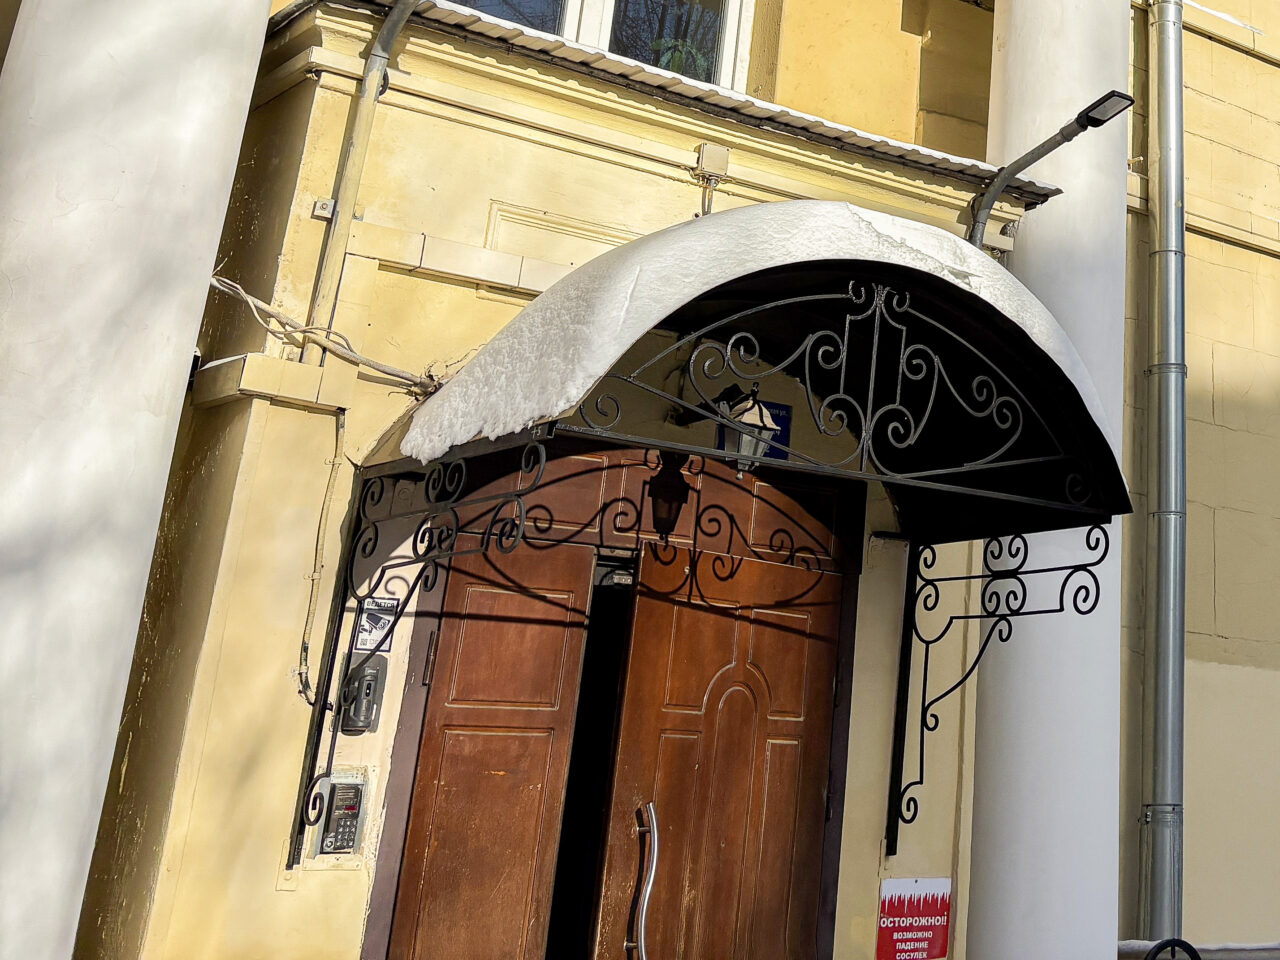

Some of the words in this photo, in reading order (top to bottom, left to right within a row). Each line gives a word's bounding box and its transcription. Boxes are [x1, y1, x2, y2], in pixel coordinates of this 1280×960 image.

[893, 931, 933, 940] ВОЗМОЖНО
[896, 941, 929, 950] ПАДЕНИЕ
[896, 952, 928, 960] СОСУЛЕК
